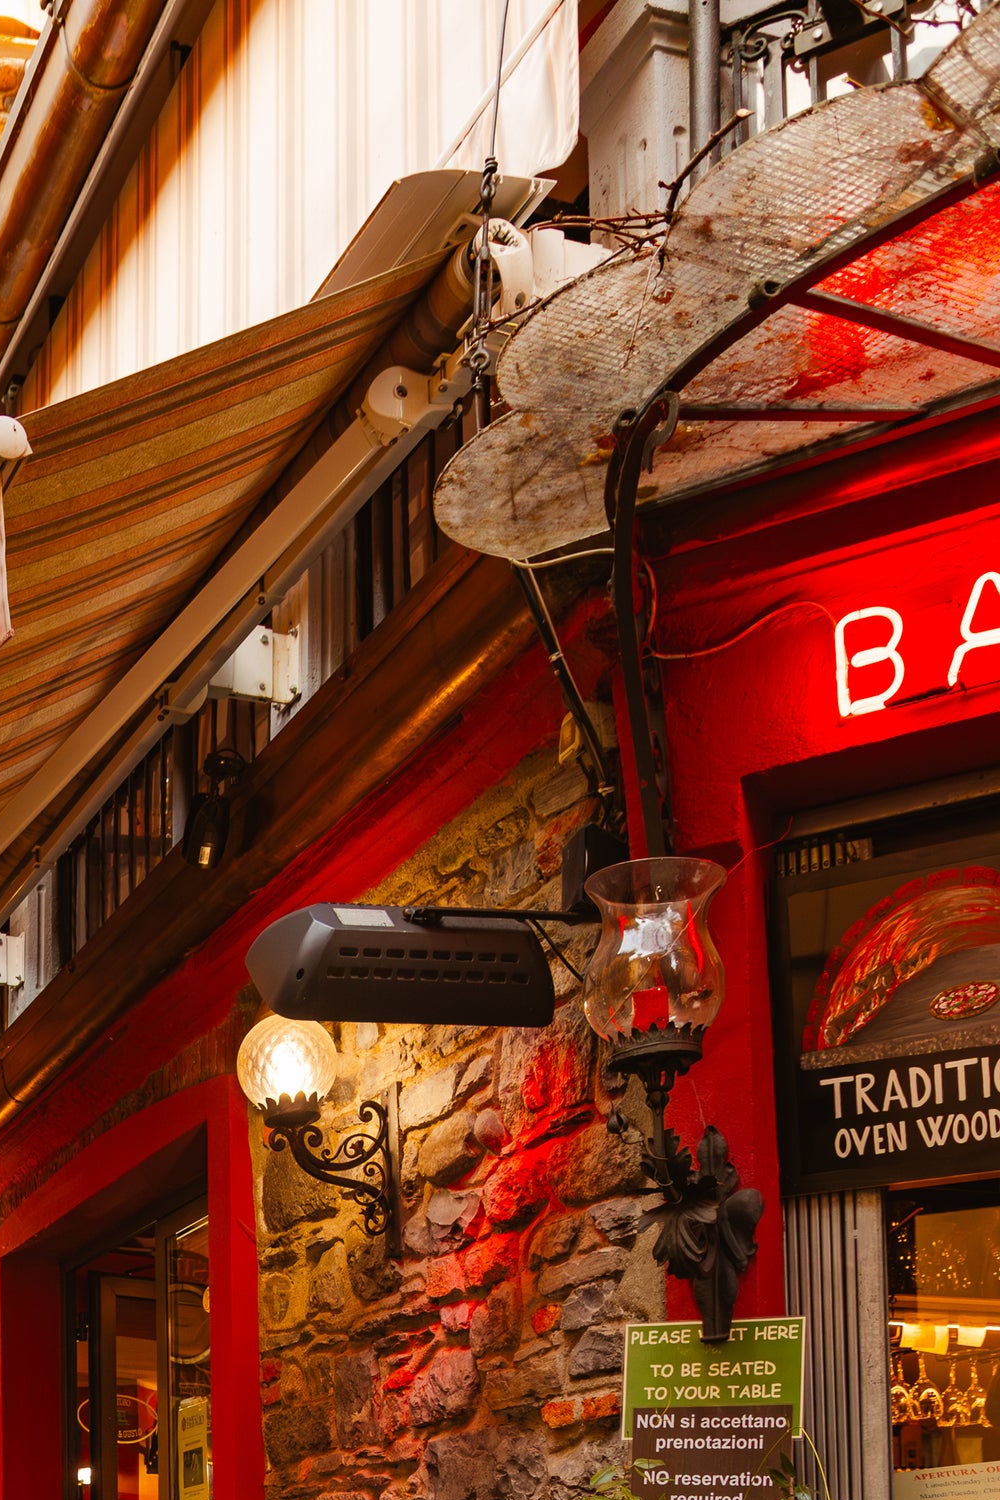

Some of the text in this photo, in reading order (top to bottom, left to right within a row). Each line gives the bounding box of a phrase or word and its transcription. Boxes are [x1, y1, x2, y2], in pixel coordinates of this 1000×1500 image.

[834, 571, 1000, 718] BA
[834, 1108, 1000, 1158] OVEN WOOD
[631, 1324, 800, 1345] PLEASE IT HERE
[650, 1360, 776, 1378] TO BE SEATED
[644, 1383, 782, 1400] TO YOUR TABLE
[636, 1413, 787, 1429] NON si accettano
[655, 1435, 764, 1452] prenotazioni
[643, 1470, 774, 1487] NO reservation
[914, 1468, 977, 1481] APERTURA
